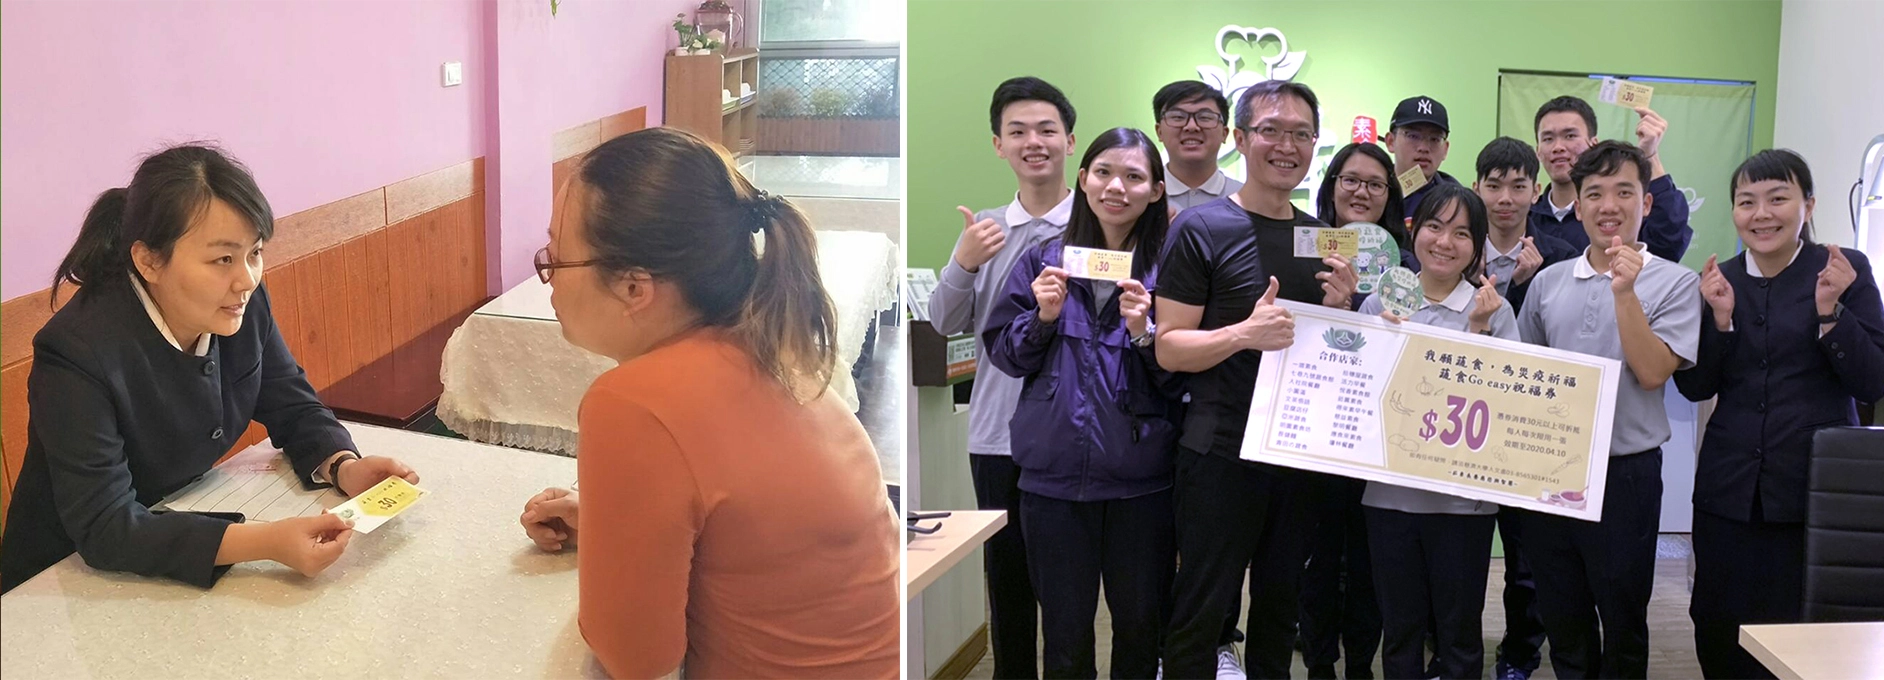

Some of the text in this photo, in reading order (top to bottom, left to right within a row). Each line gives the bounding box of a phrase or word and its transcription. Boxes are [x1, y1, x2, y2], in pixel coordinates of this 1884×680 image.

[1417, 99, 1432, 114] NY
[1353, 118, 1372, 144] 素
[1418, 394, 1490, 451] $30
